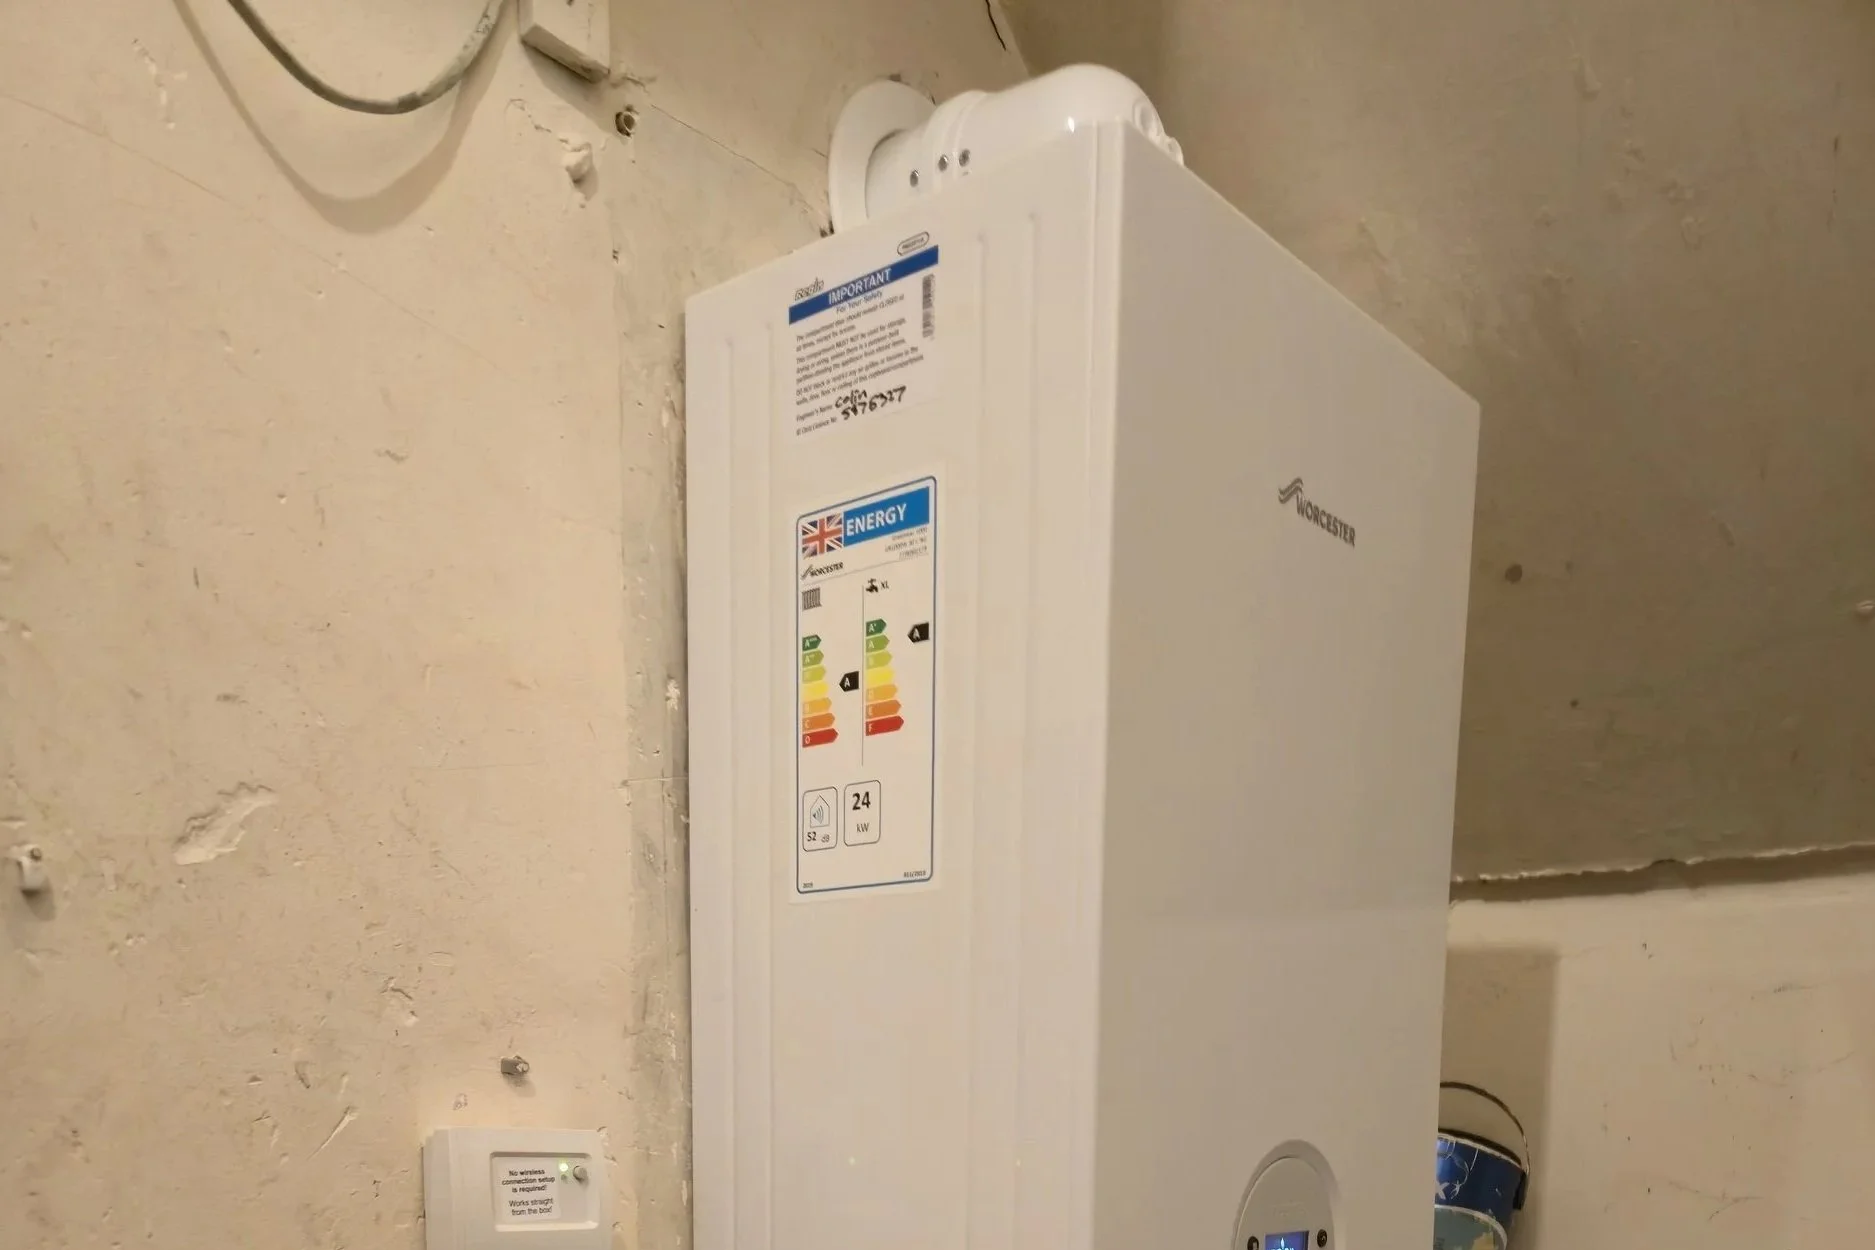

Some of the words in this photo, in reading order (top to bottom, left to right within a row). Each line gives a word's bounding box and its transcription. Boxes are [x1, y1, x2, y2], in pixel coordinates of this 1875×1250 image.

[829, 268, 892, 305] IMPORTANT
[846, 503, 907, 537] ENERGY
[1296, 491, 1356, 548] WORCESTER
[852, 791, 871, 811] 24
[856, 821, 870, 833] kW
[520, 1168, 545, 1176] wireless
[502, 1177, 537, 1186] connection
[538, 1176, 556, 1184] setup
[509, 1200, 530, 1208] Works
[531, 1197, 554, 1207] straight
[512, 1207, 527, 1216] from
[528, 1206, 538, 1215] the
[540, 1205, 553, 1214] box!
